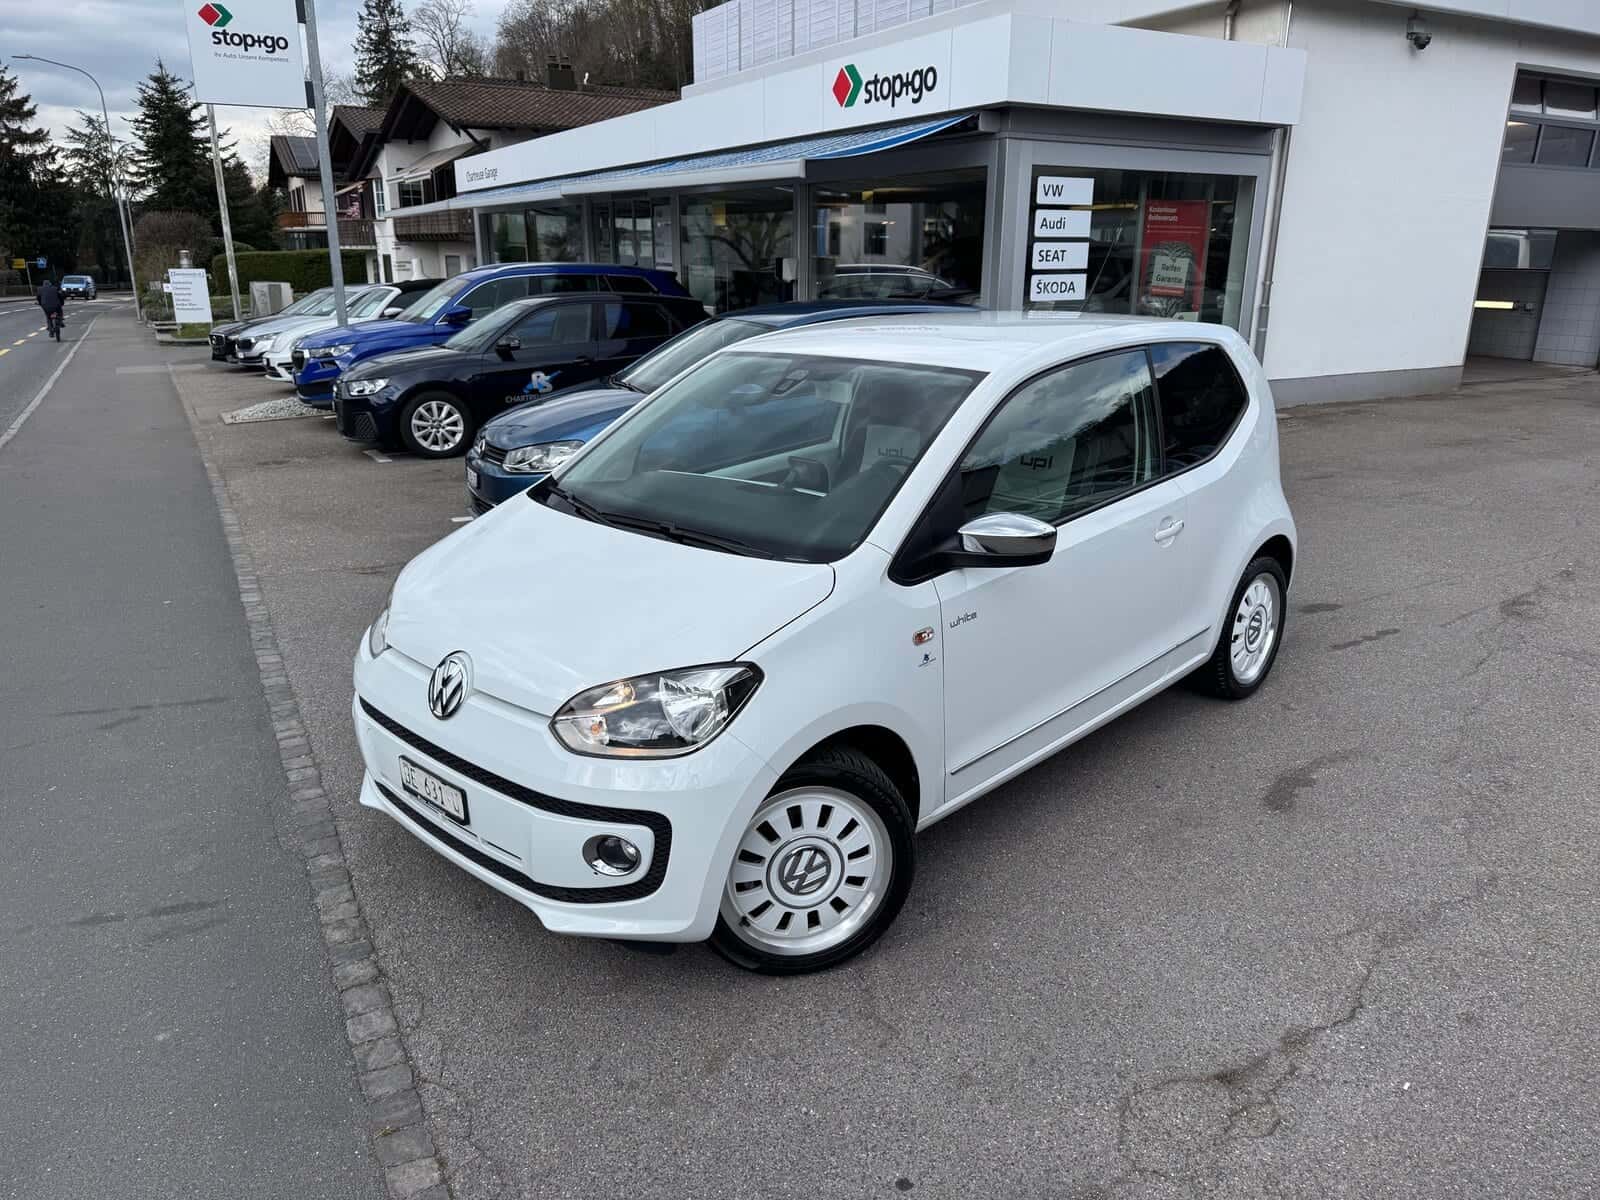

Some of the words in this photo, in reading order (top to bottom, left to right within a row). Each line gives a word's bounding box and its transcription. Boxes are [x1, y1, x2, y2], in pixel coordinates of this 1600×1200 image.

[211, 29, 289, 54] stop+go
[864, 66, 938, 108] stop+go
[1042, 183, 1064, 198] VW
[1040, 216, 1066, 230] Audi
[1038, 249, 1067, 262] SEAT
[1036, 279, 1076, 294] ŠKODA
[1020, 455, 1054, 471] up!
[949, 611, 977, 629] white
